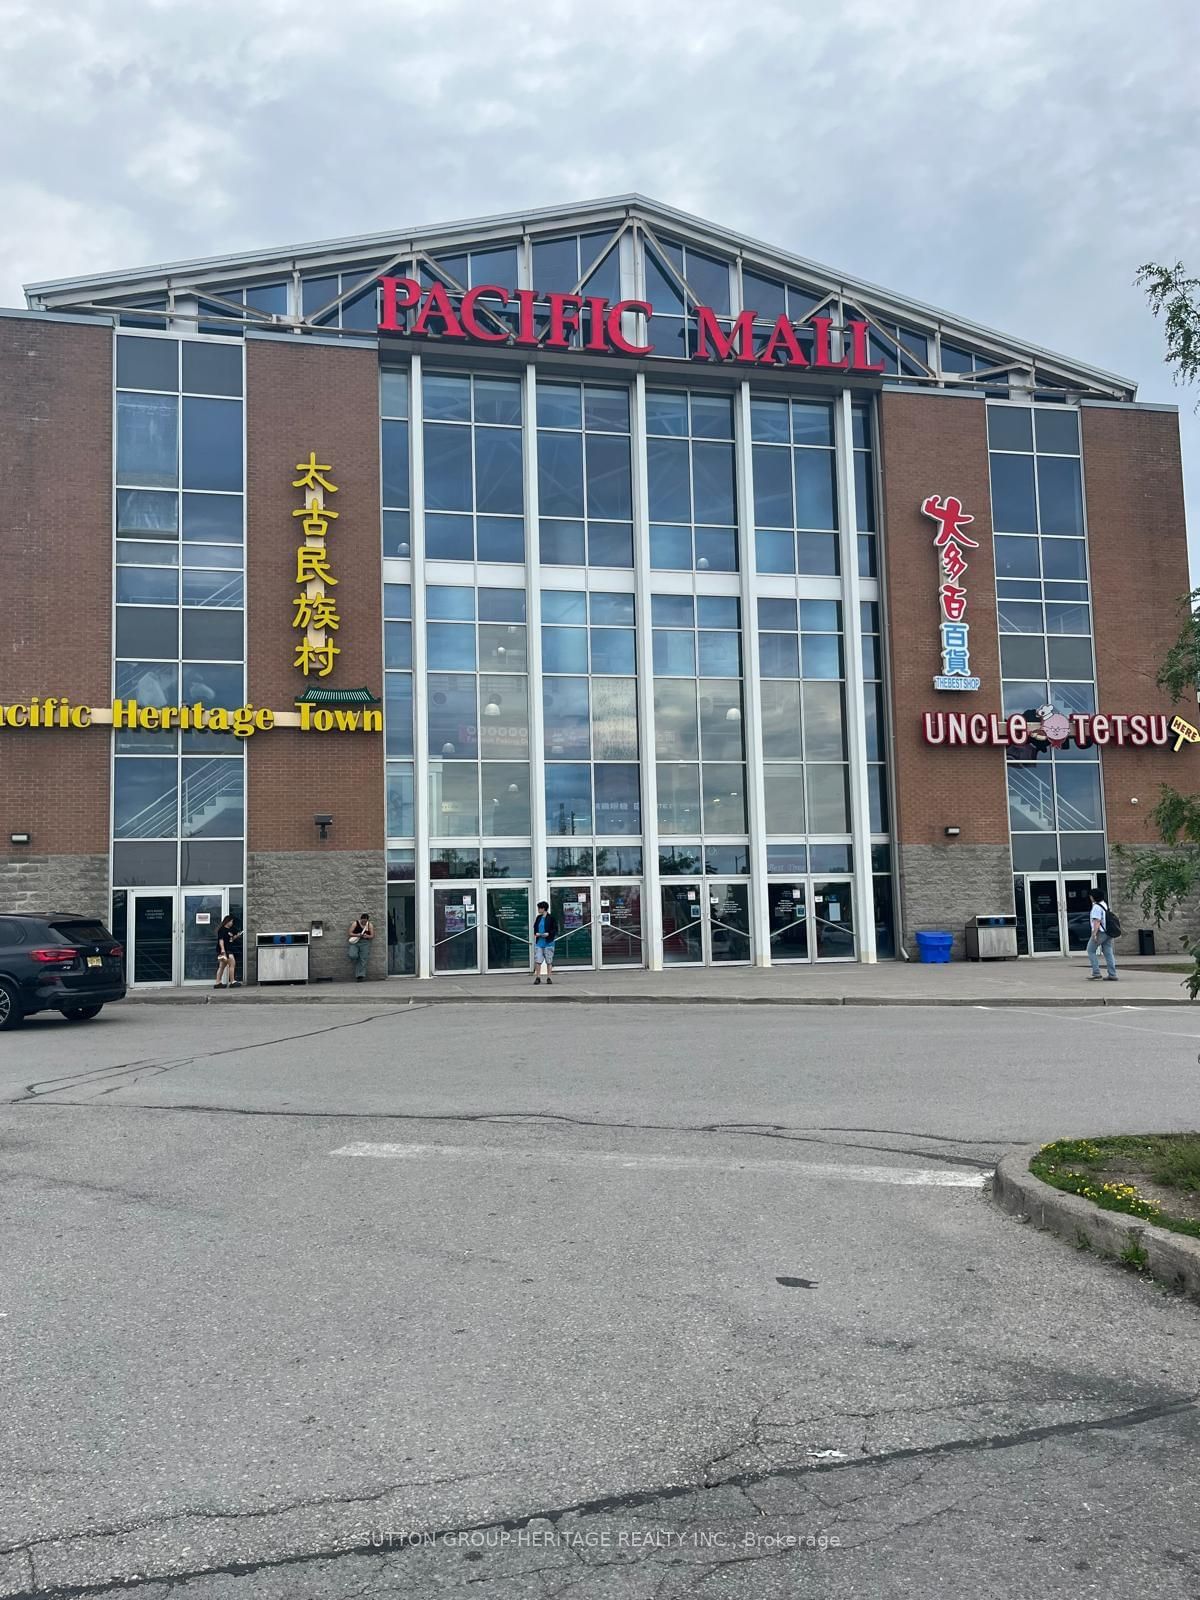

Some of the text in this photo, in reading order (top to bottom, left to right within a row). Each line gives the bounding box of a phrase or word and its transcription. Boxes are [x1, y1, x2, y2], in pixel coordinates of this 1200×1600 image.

[377, 276, 885, 373] PACIFIC MALL
[292, 451, 341, 677] 太古民族村
[0, 696, 383, 737] cific Heritage Town
[1173, 719, 1198, 741] HERE
